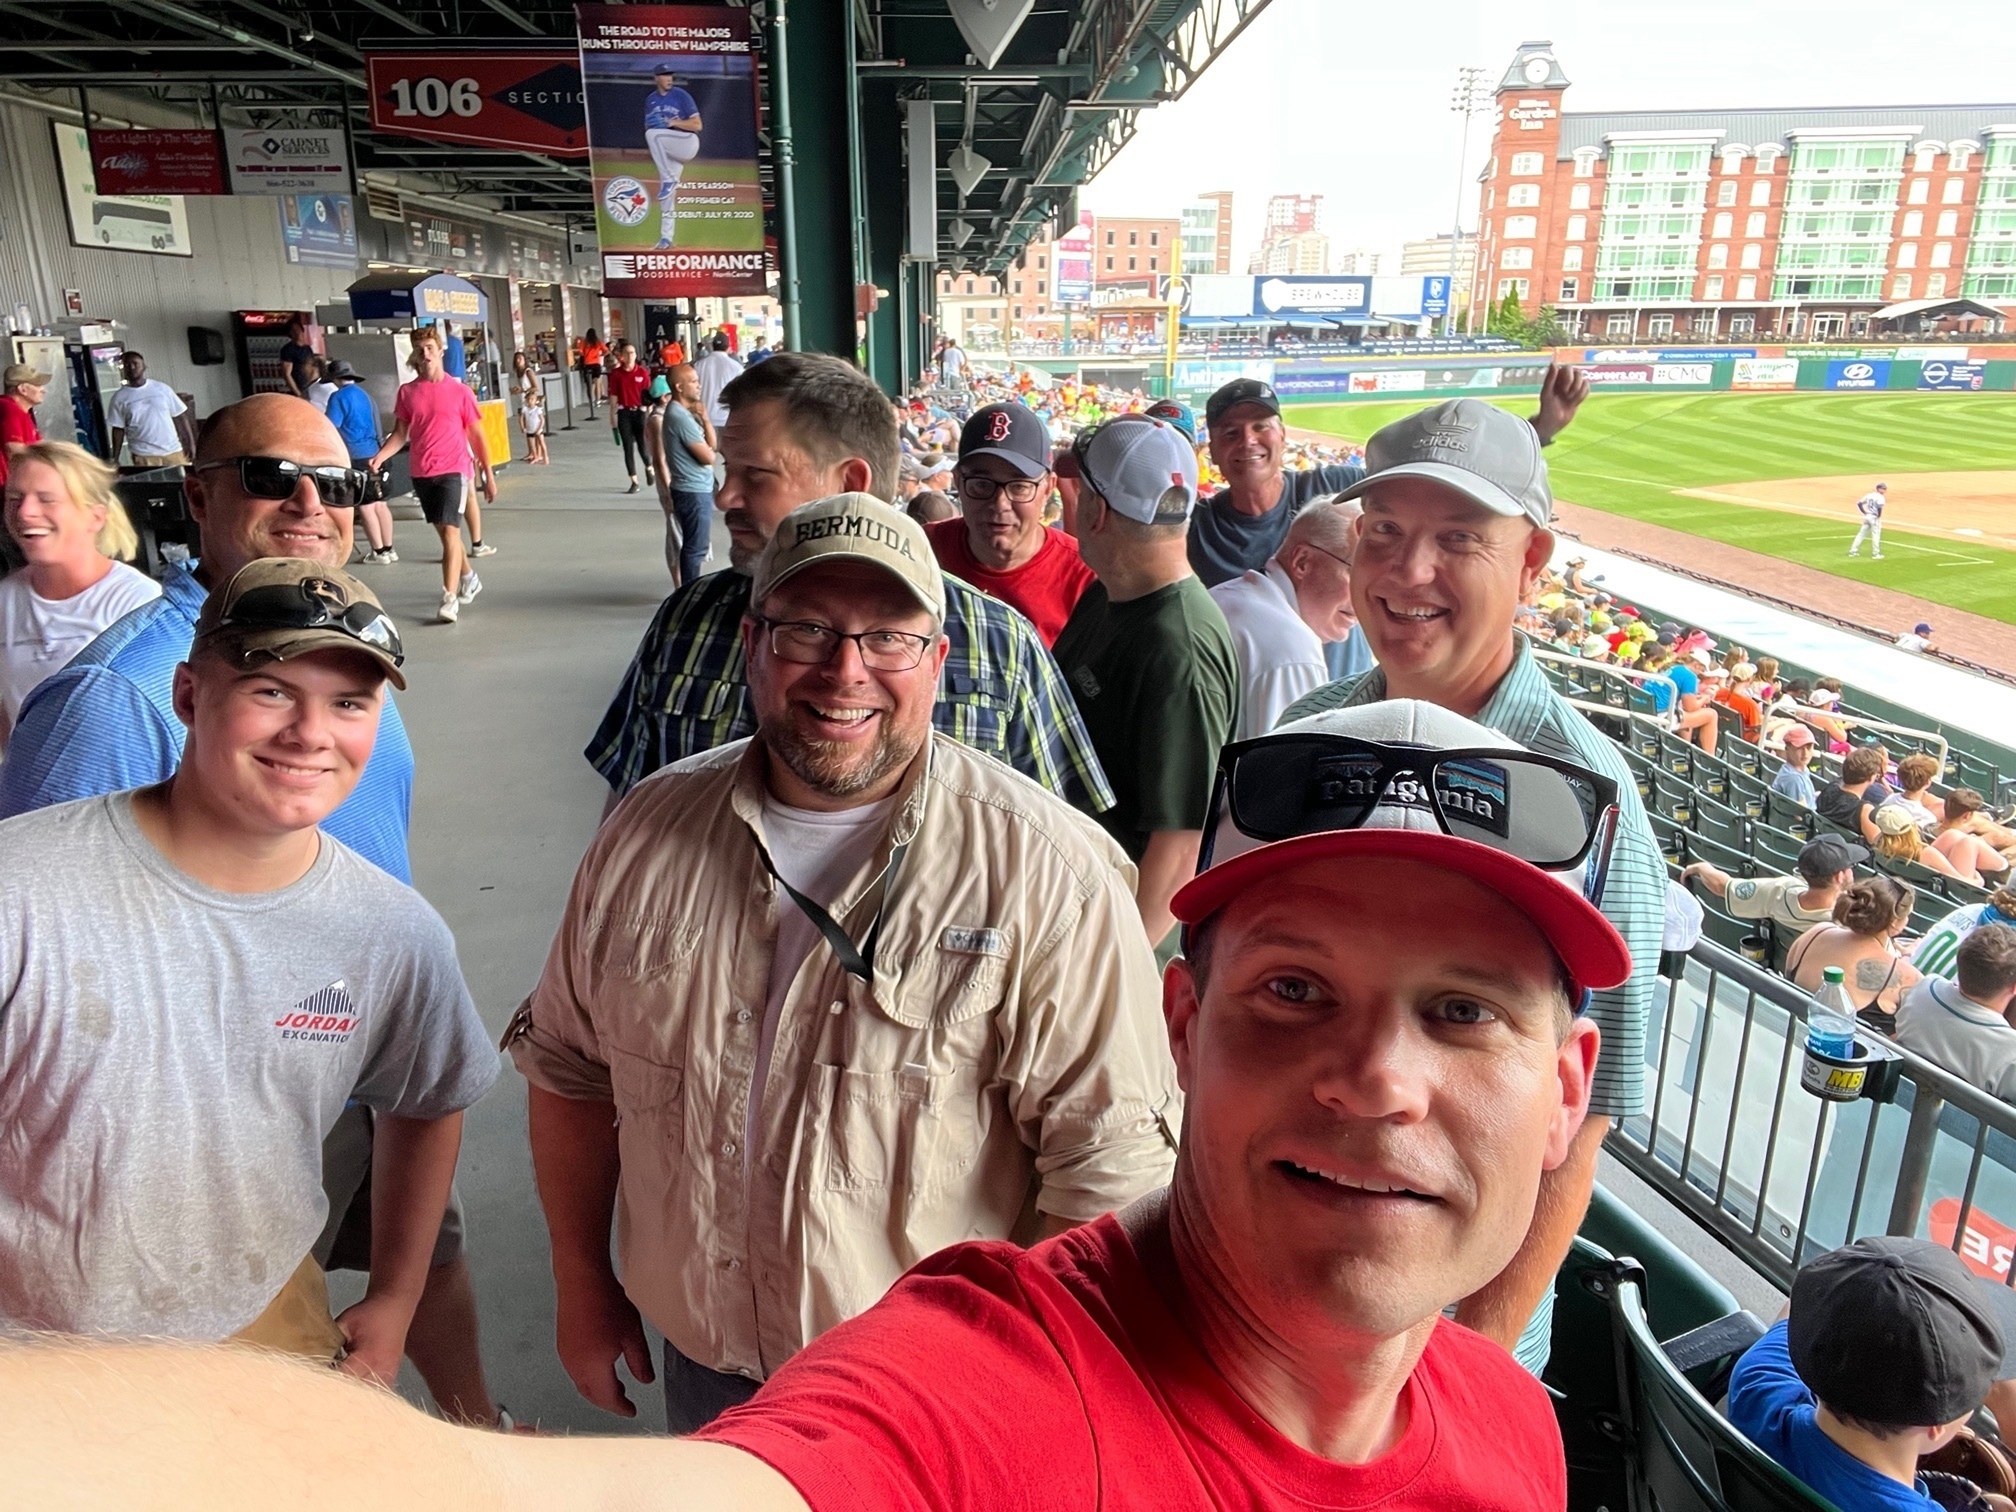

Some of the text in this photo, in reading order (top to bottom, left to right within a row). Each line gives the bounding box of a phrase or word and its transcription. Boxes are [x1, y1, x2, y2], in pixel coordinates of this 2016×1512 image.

[598, 25, 731, 38] THE ROAD TO THE MAJORS
[582, 39, 750, 52] RUNS THROUGH NEW HAMPSHIRE
[391, 77, 483, 118] 106
[508, 91, 585, 104] SECTIO
[280, 137, 329, 147] CADNET
[281, 146, 330, 155] SERVICES
[676, 182, 734, 190] NATE PEARSON
[636, 254, 763, 270] PERFORMANCE
[637, 270, 702, 279] FOODSERVICE
[1668, 366, 1708, 381] CMC
[1837, 379, 1875, 387] HYUNDAI
[984, 411, 1012, 441] B
[792, 515, 916, 562] BERMUDA
[1825, 1068, 1865, 1089] MB
